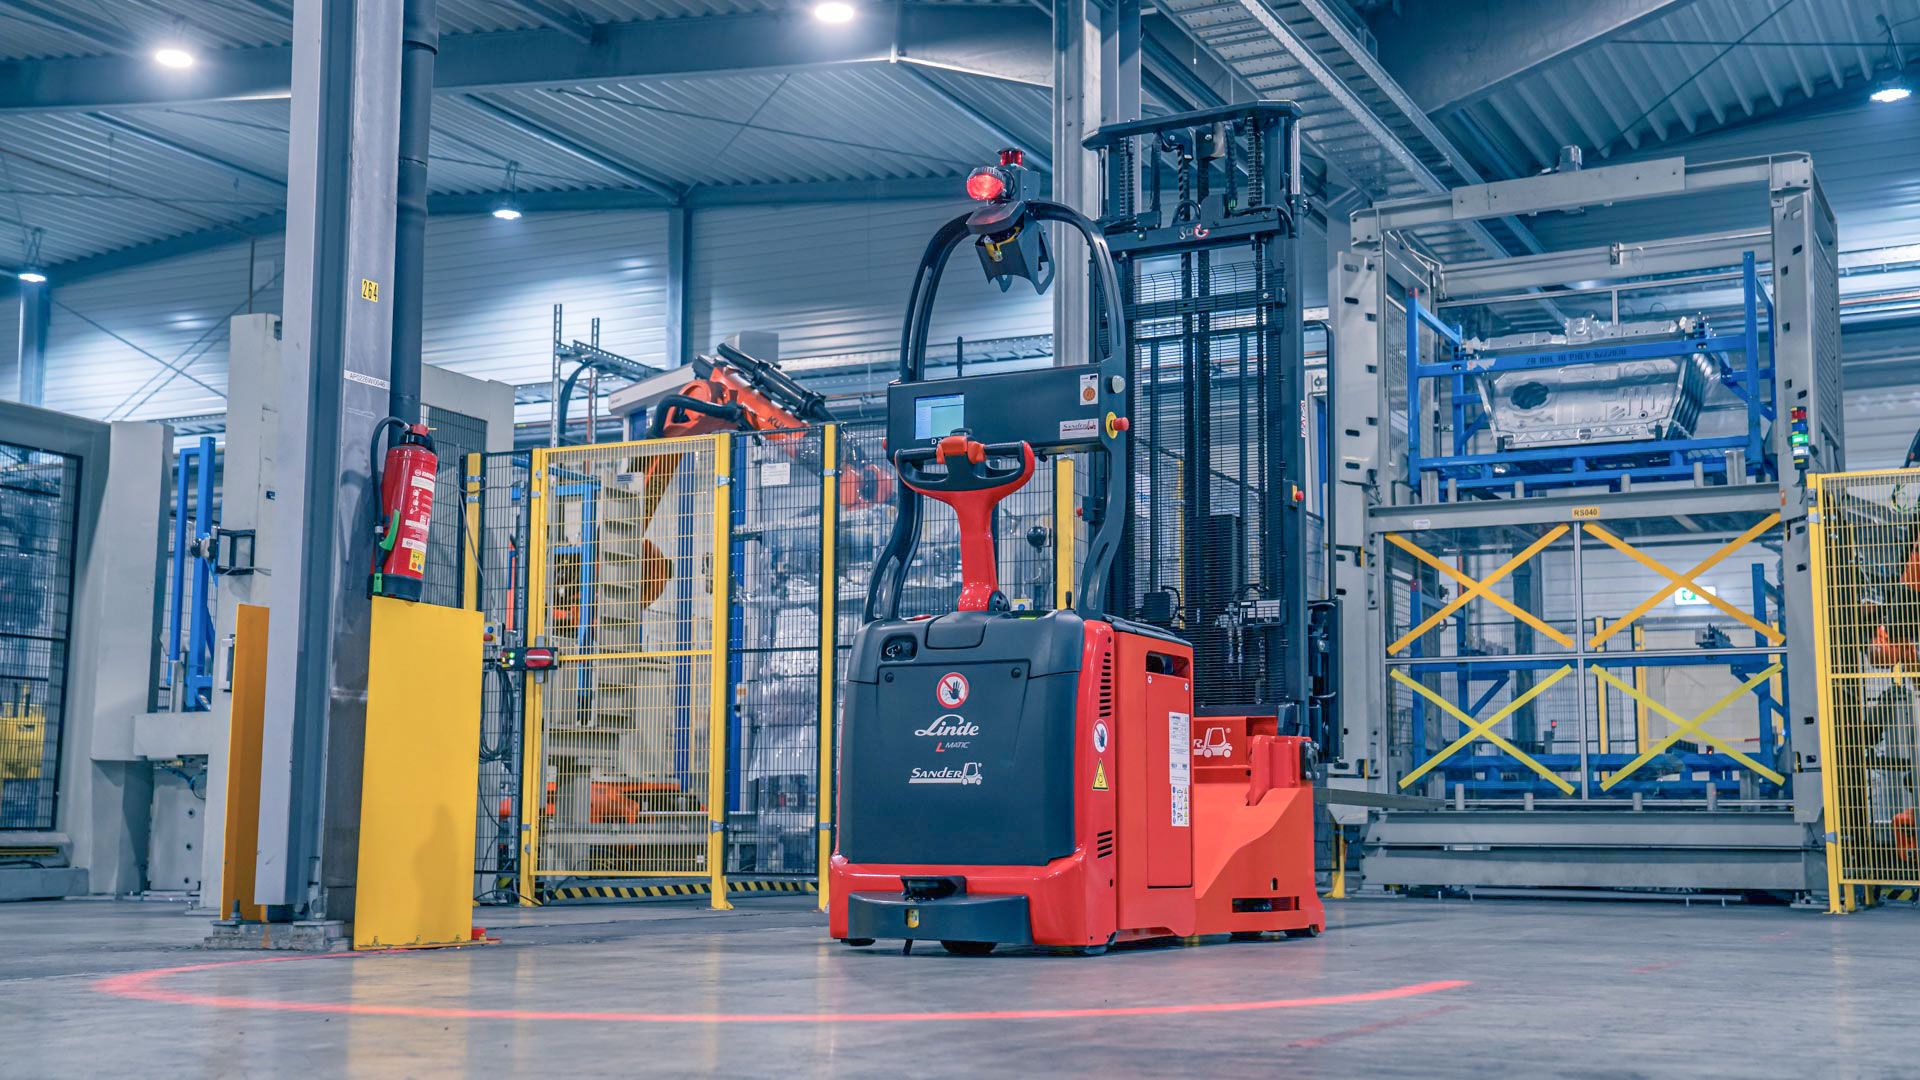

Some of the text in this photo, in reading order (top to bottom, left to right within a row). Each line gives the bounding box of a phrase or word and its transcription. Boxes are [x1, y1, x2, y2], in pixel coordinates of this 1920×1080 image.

[363, 280, 378, 301] 264
[1574, 508, 1598, 517] RS040
[914, 714, 979, 736] Linde
[936, 741, 971, 752] L MATIC
